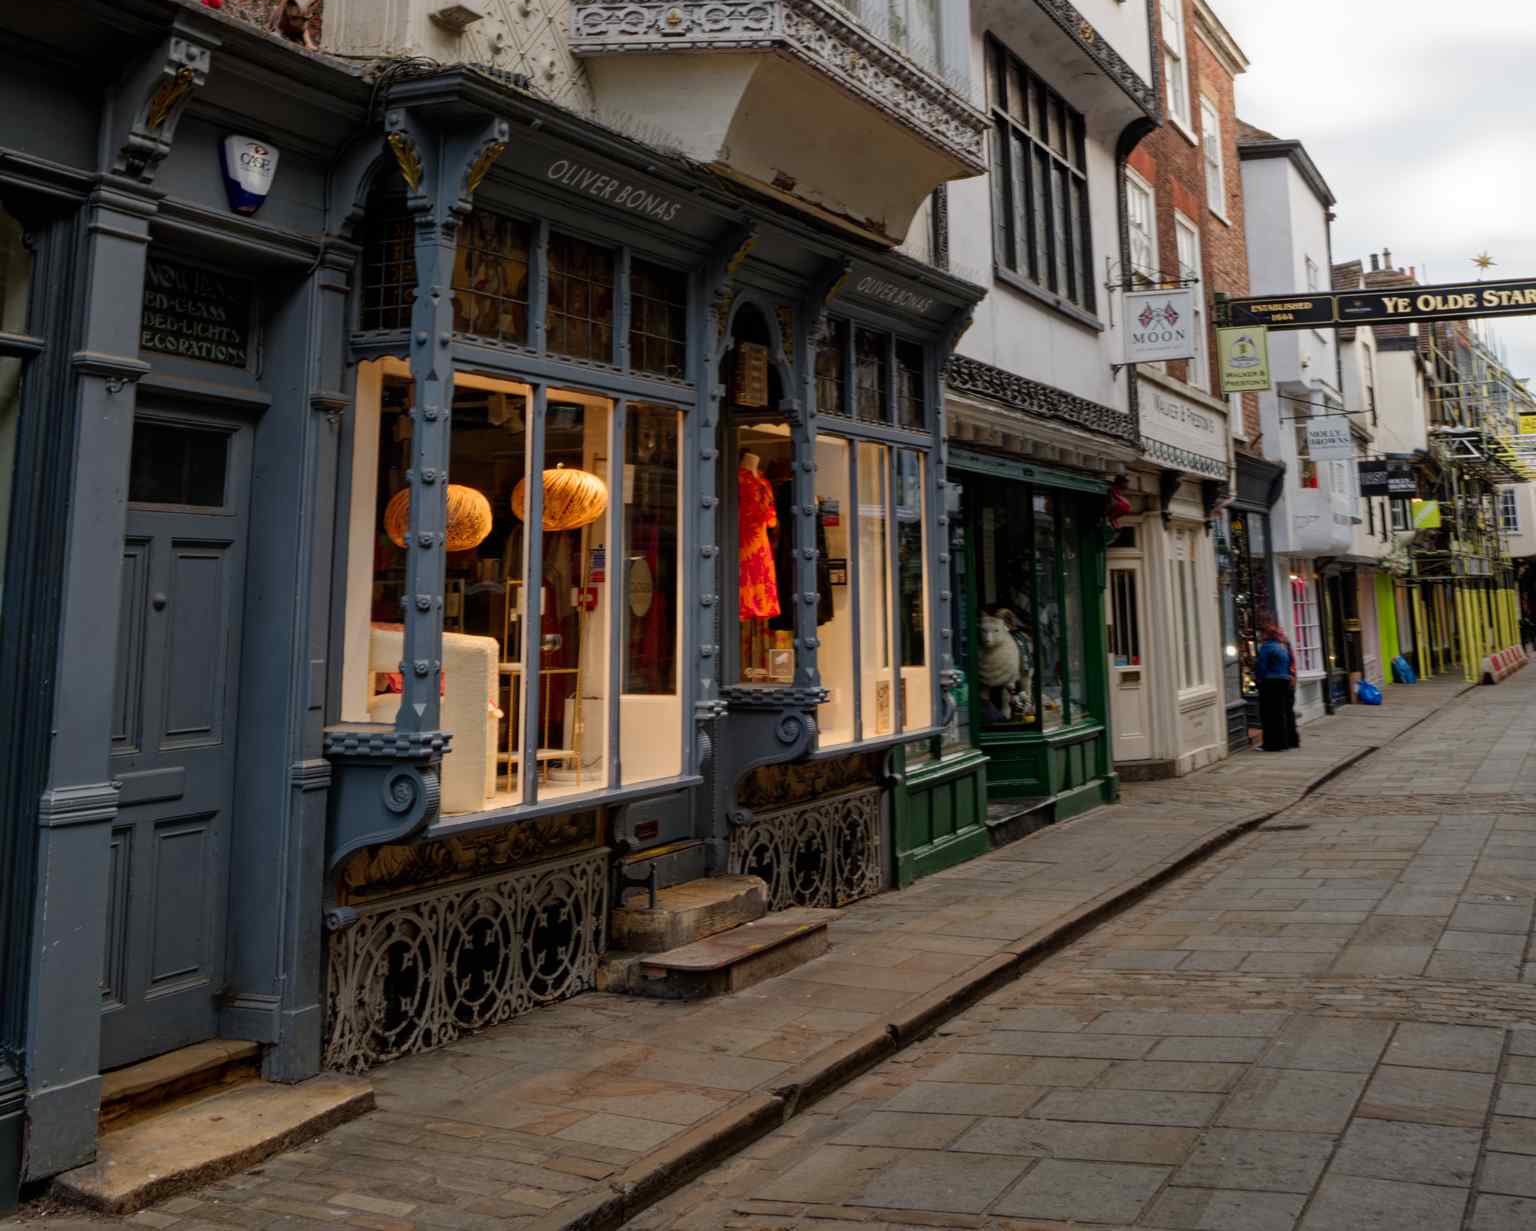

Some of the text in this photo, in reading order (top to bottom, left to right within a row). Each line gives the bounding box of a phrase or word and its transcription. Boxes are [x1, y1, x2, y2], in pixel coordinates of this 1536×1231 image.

[547, 159, 681, 221] OLIVER BONAS
[857, 276, 899, 301] OLIVER
[1416, 292, 1478, 312] OLDE
[142, 330, 247, 362] ECORATIONS
[1132, 329, 1185, 345] MOON
